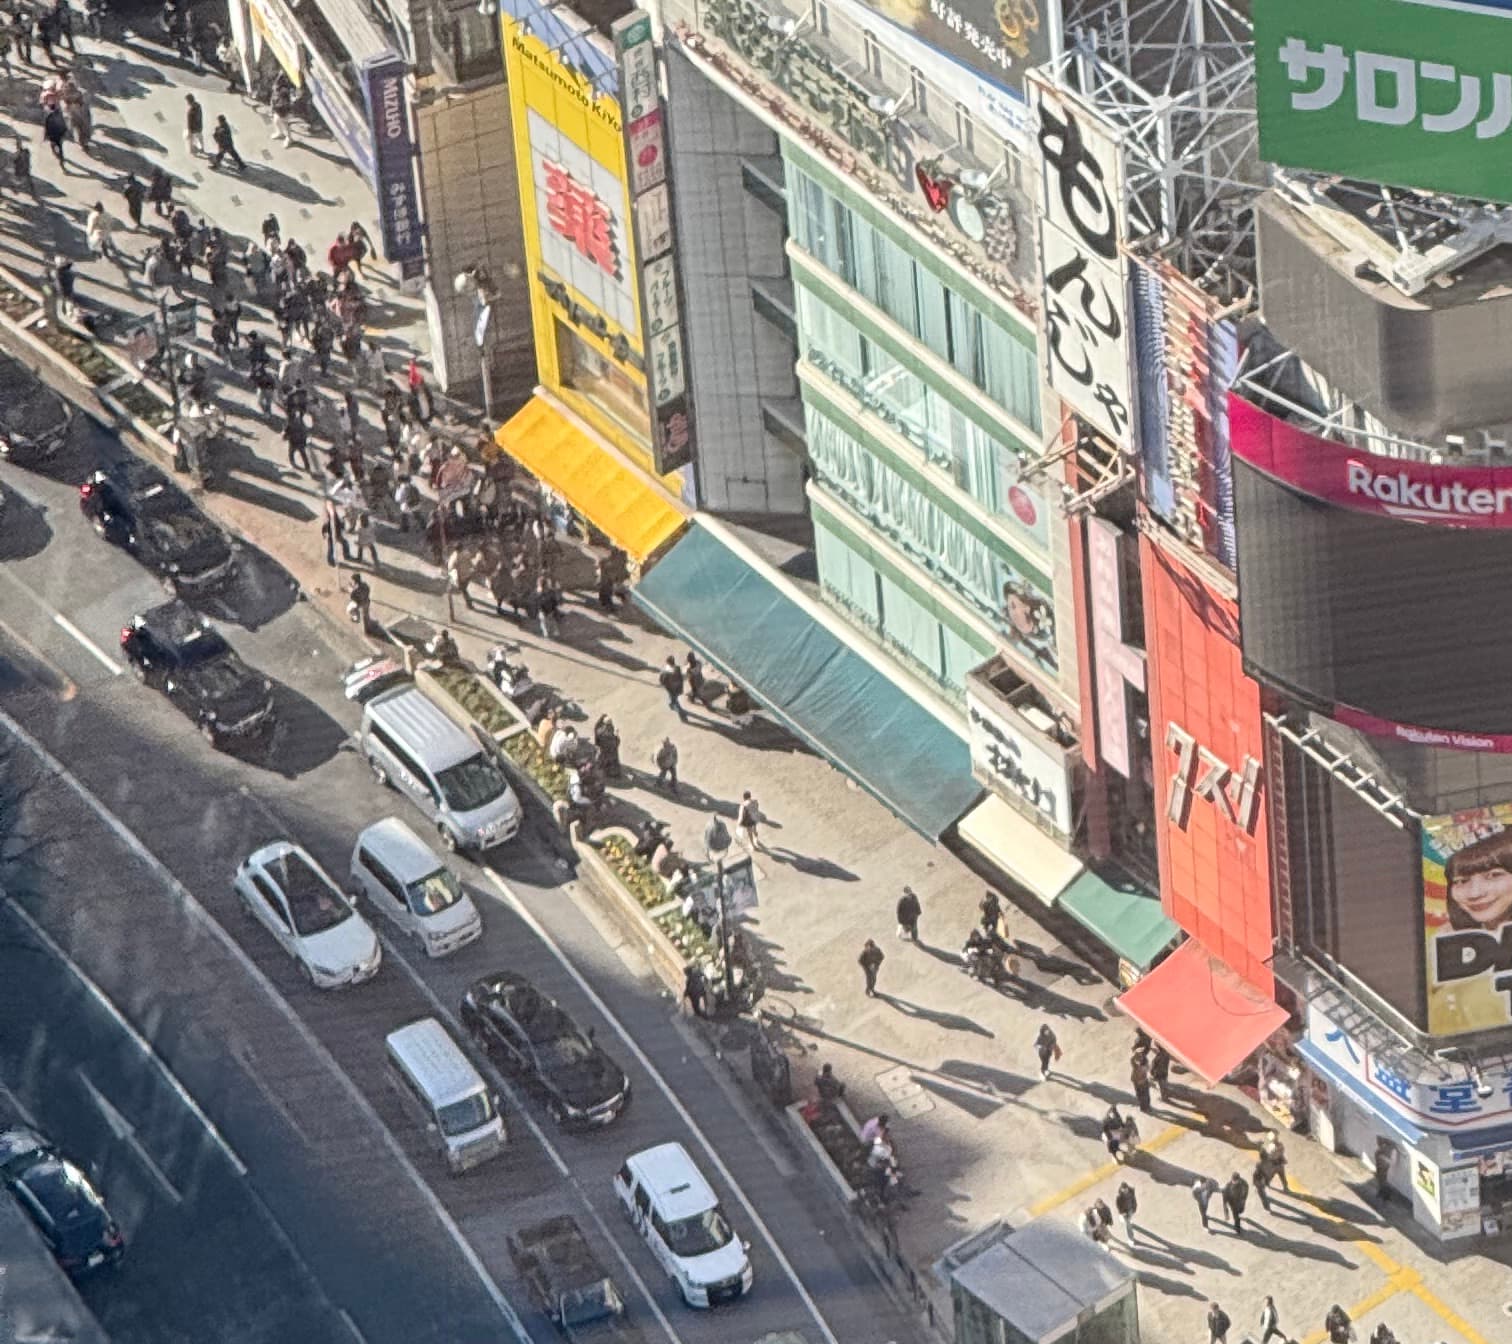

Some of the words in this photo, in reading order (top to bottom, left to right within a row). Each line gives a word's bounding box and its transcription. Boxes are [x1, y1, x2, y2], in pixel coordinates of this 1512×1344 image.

[512, 36, 590, 107] Matsumoto
[382, 78, 402, 139] MIZUHO
[542, 158, 621, 281] 薬
[1038, 97, 1128, 437] もんじゃ
[1396, 725, 1450, 745] Rakuten
[1452, 734, 1494, 749] Vision
